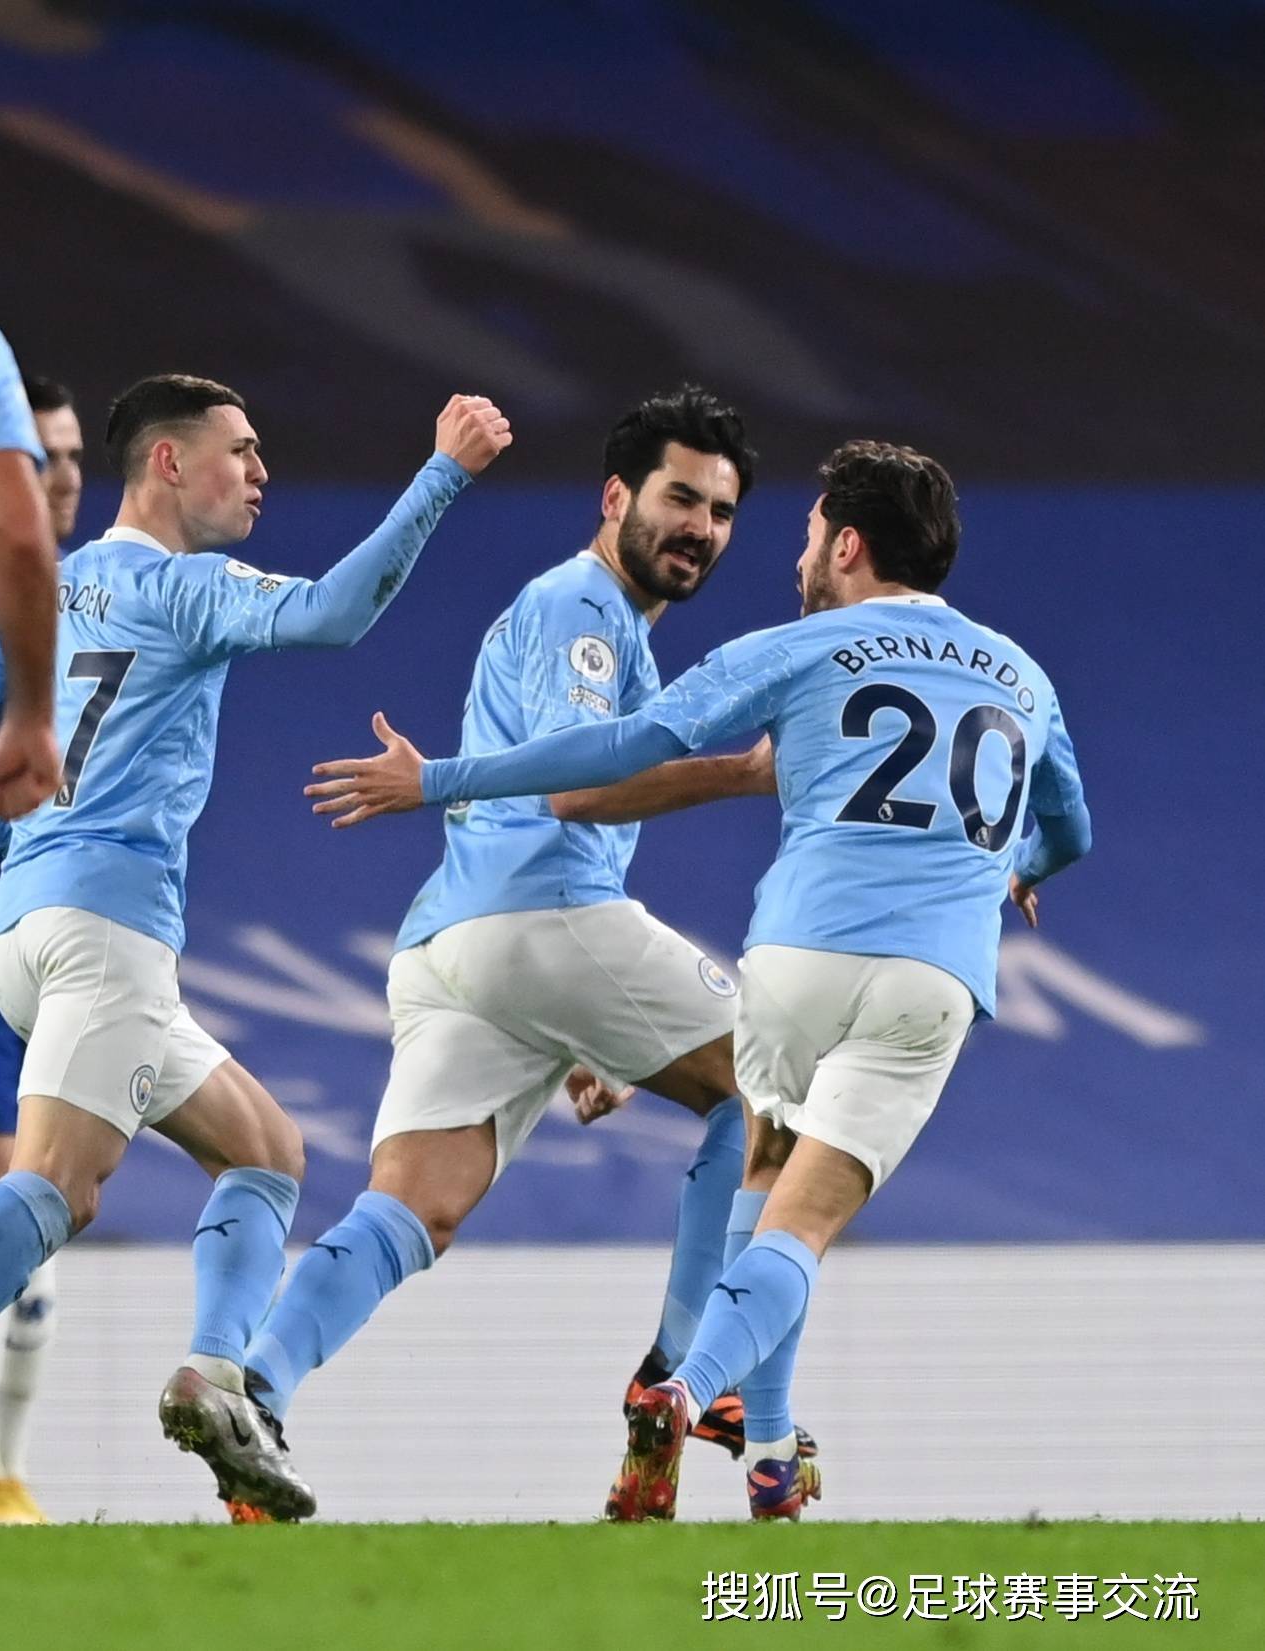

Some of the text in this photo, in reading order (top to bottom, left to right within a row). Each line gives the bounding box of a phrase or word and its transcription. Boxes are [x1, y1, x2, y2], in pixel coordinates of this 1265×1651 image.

[53, 651, 137, 808] 7
[831, 635, 1035, 714] BERNARDO
[834, 682, 1027, 852] 20
